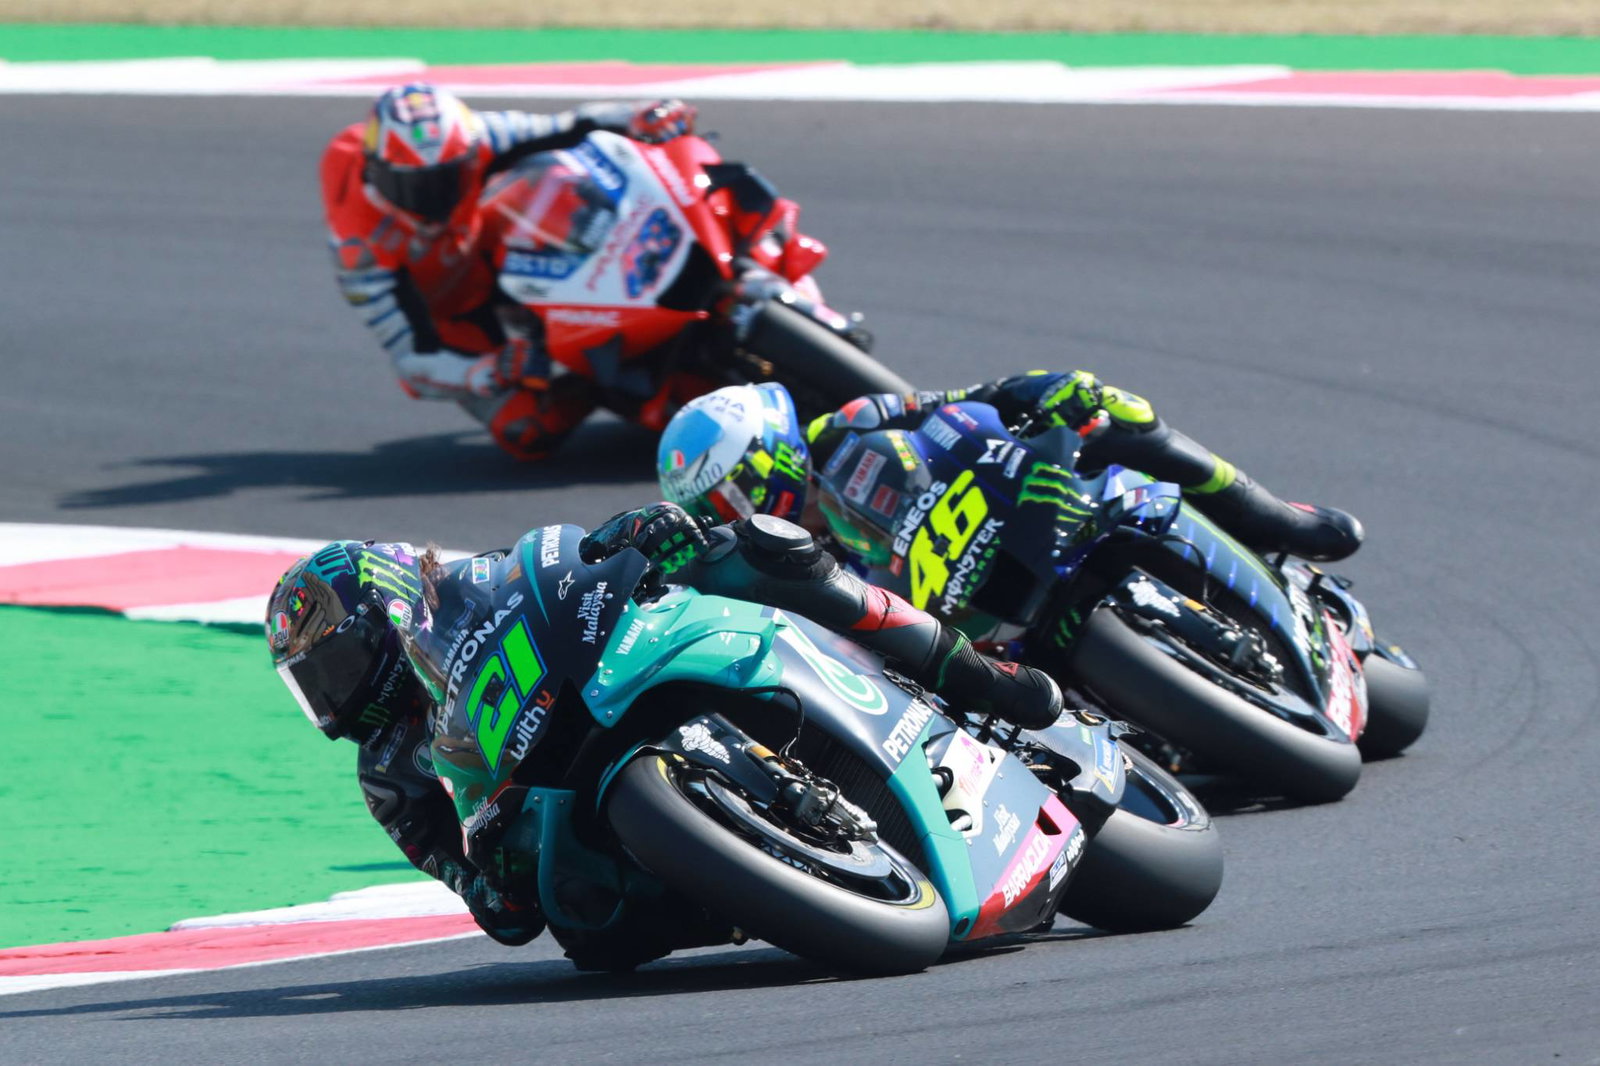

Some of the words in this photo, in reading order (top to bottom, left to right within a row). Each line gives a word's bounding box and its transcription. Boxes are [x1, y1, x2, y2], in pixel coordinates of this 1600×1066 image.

[541, 525, 561, 568] PETRONAS
[893, 480, 947, 557] ENEOS
[909, 469, 988, 610] 46
[941, 518, 1004, 615] MONSTER
[577, 592, 593, 619] Visit
[582, 581, 608, 645] Malaysia
[615, 618, 646, 655] YAMAHA
[439, 592, 524, 735] PETRONAS
[442, 629, 469, 672] YAMAHA
[465, 615, 548, 778] 21
[882, 698, 933, 763] PETRONAS
[1002, 832, 1053, 909] BARRACUDA
